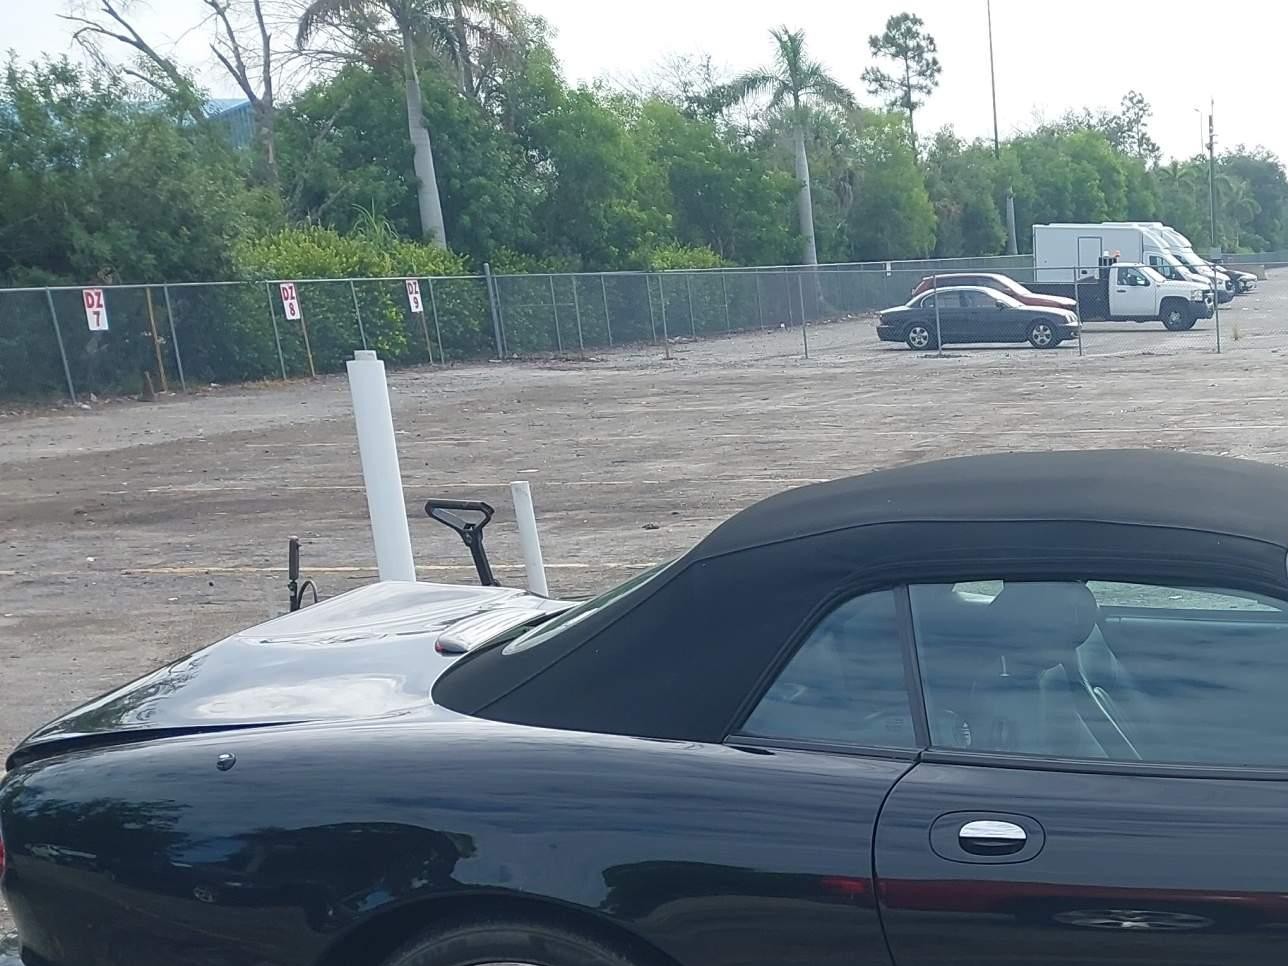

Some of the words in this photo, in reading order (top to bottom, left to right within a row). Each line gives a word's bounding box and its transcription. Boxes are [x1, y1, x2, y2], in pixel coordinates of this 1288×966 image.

[281, 285, 295, 301] DZ
[407, 281, 419, 295] DZ
[84, 291, 104, 309] DZ
[413, 296, 419, 309] 9
[288, 302, 296, 317] 8
[92, 310, 101, 327] 7
